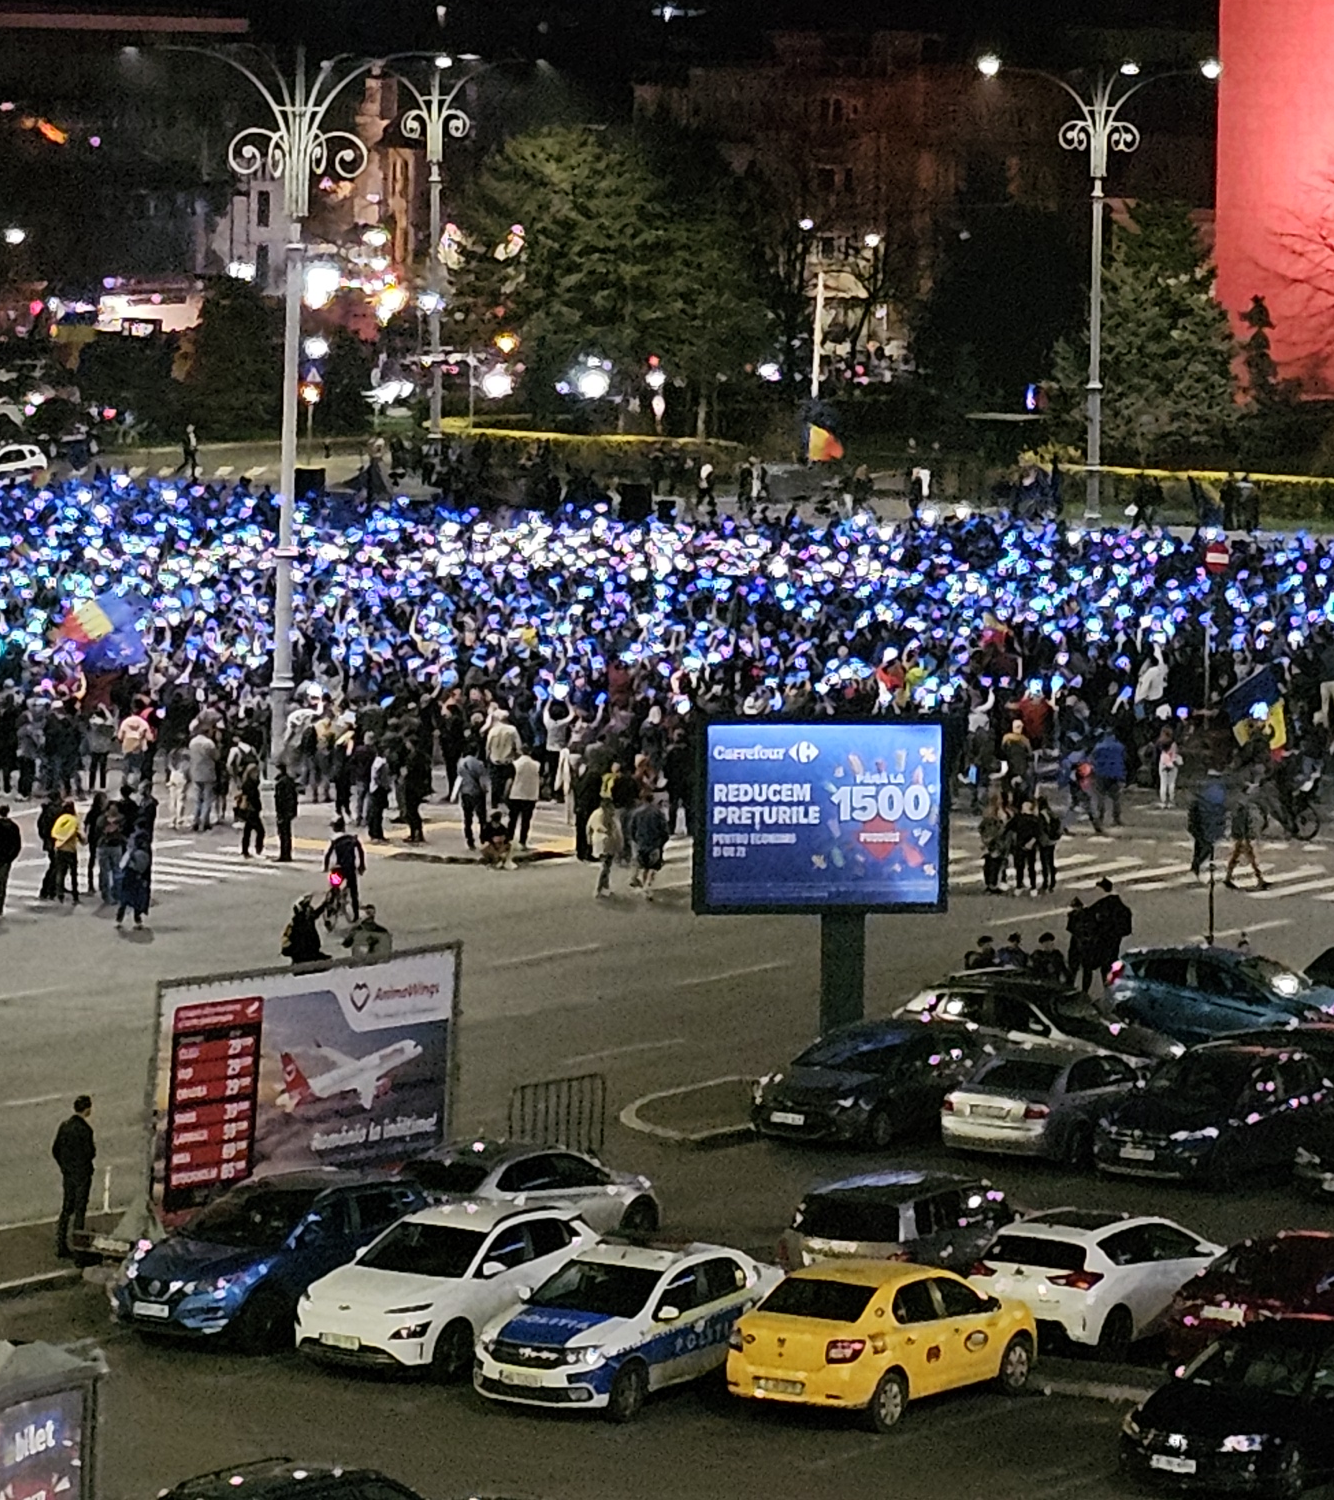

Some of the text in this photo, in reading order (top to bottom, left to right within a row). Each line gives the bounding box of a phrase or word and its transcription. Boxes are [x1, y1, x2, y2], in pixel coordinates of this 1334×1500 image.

[713, 744, 786, 760] Carrefour
[889, 773, 905, 784] LA
[713, 784, 811, 802] REDUCEM
[830, 785, 931, 821] 1500
[374, 984, 440, 1001] AnimaWings
